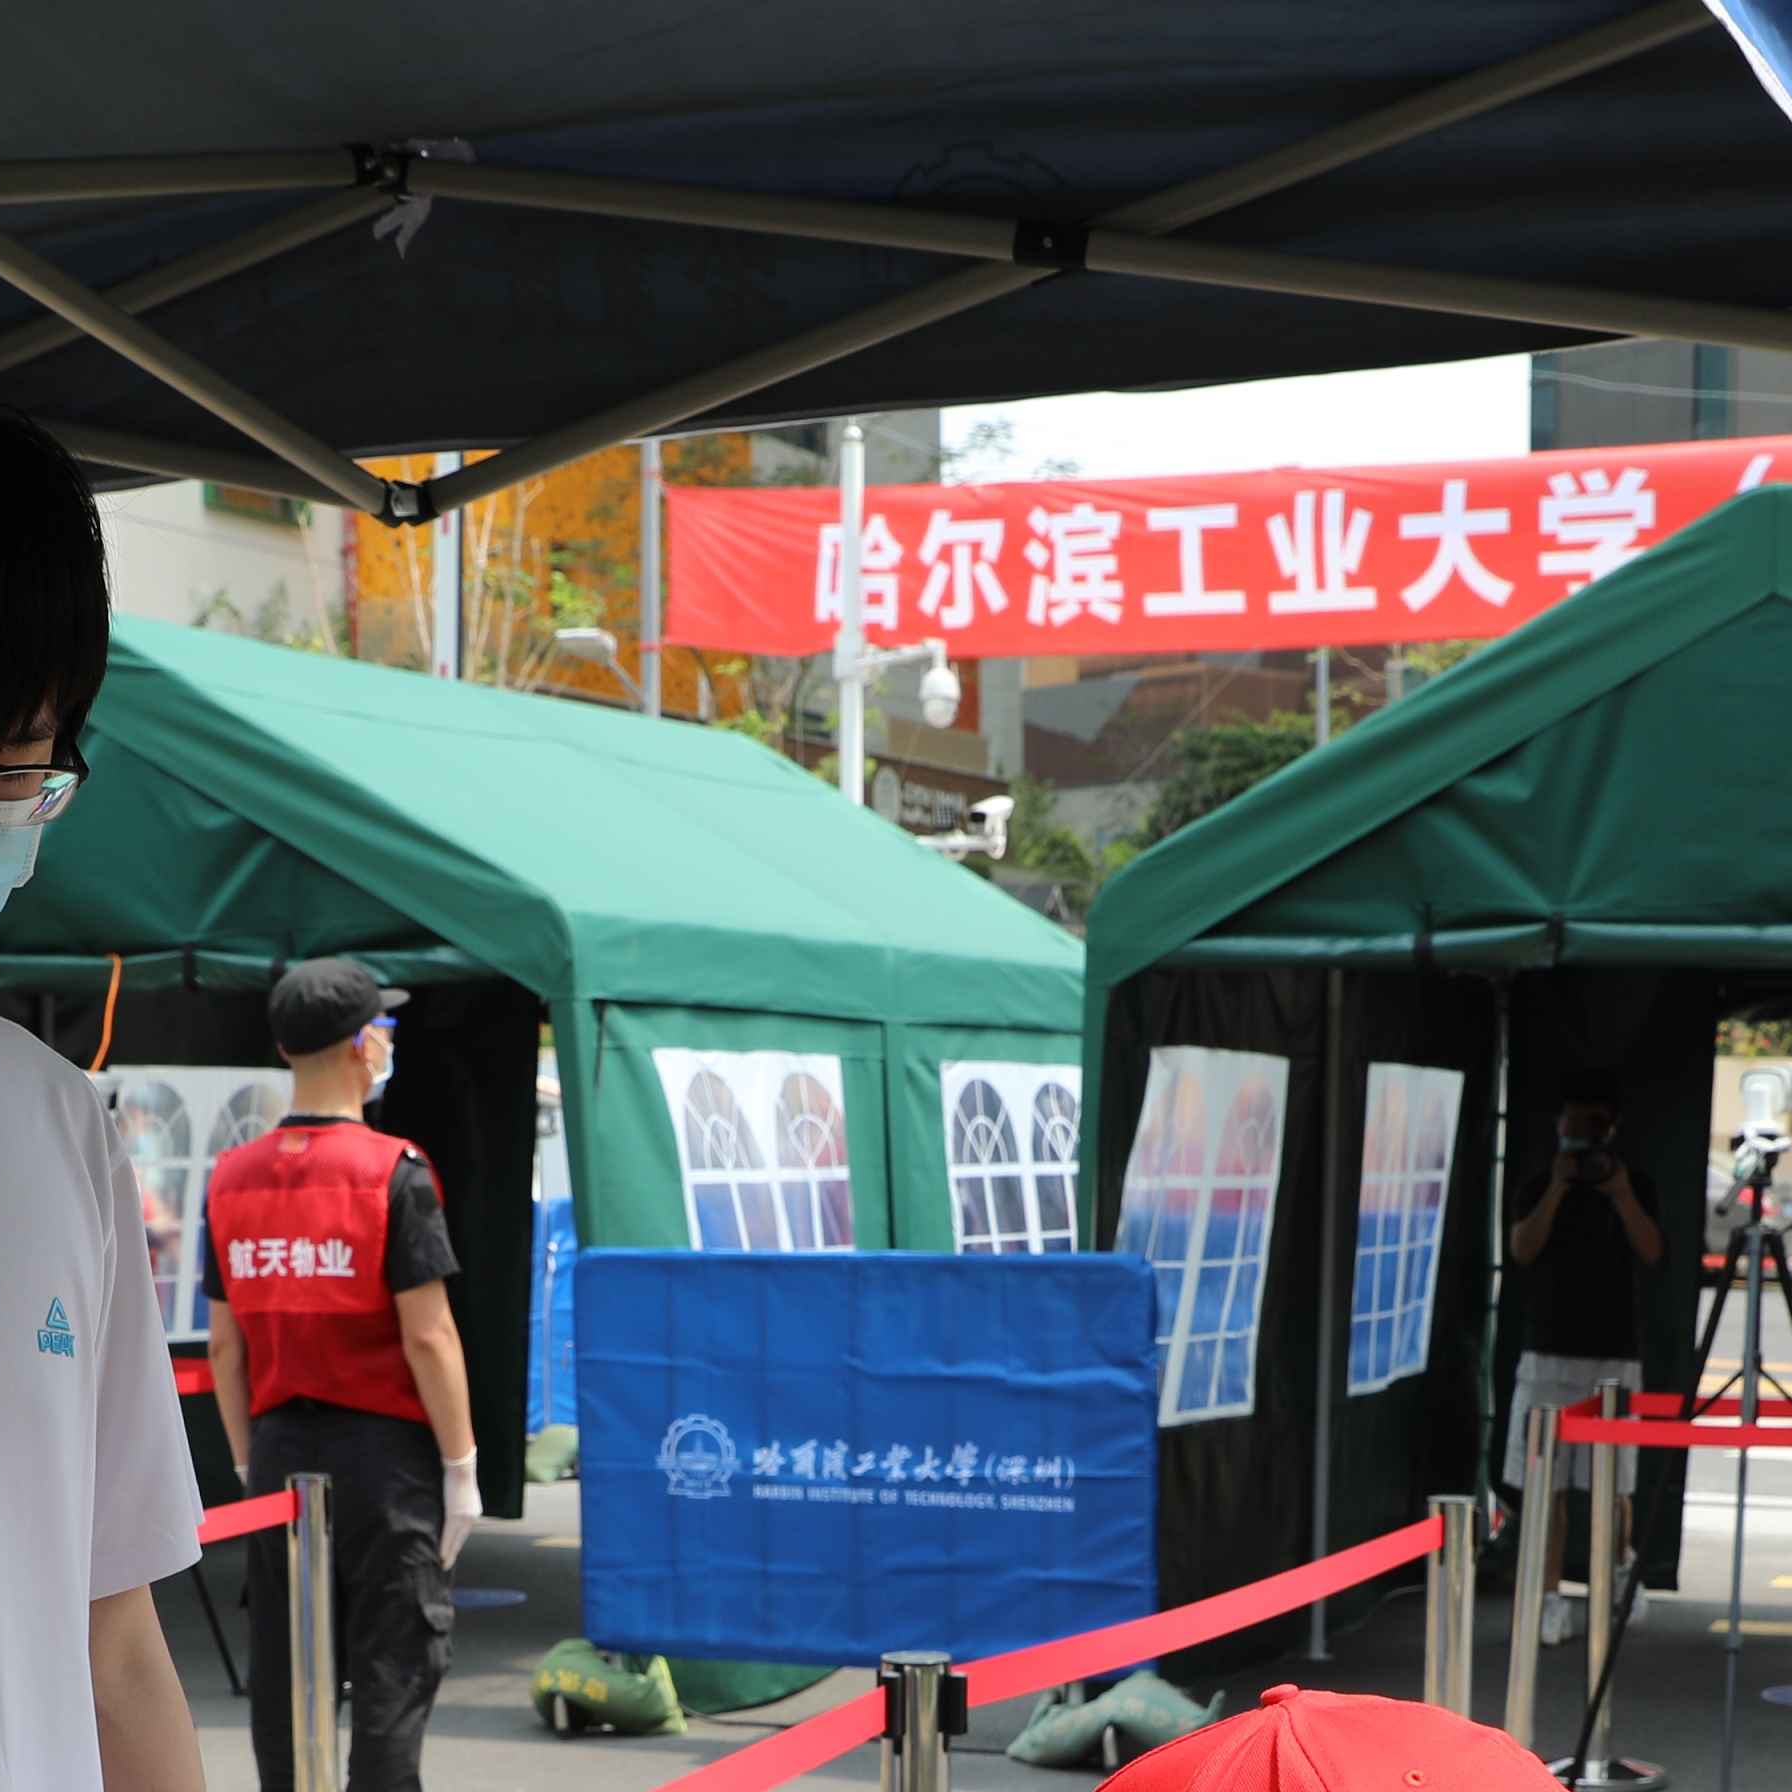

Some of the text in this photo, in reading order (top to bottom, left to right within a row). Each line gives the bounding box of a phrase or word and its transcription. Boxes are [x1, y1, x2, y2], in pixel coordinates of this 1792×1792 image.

[227, 1236, 356, 1280] 航天物业
[37, 1328, 75, 1358] PEAK
